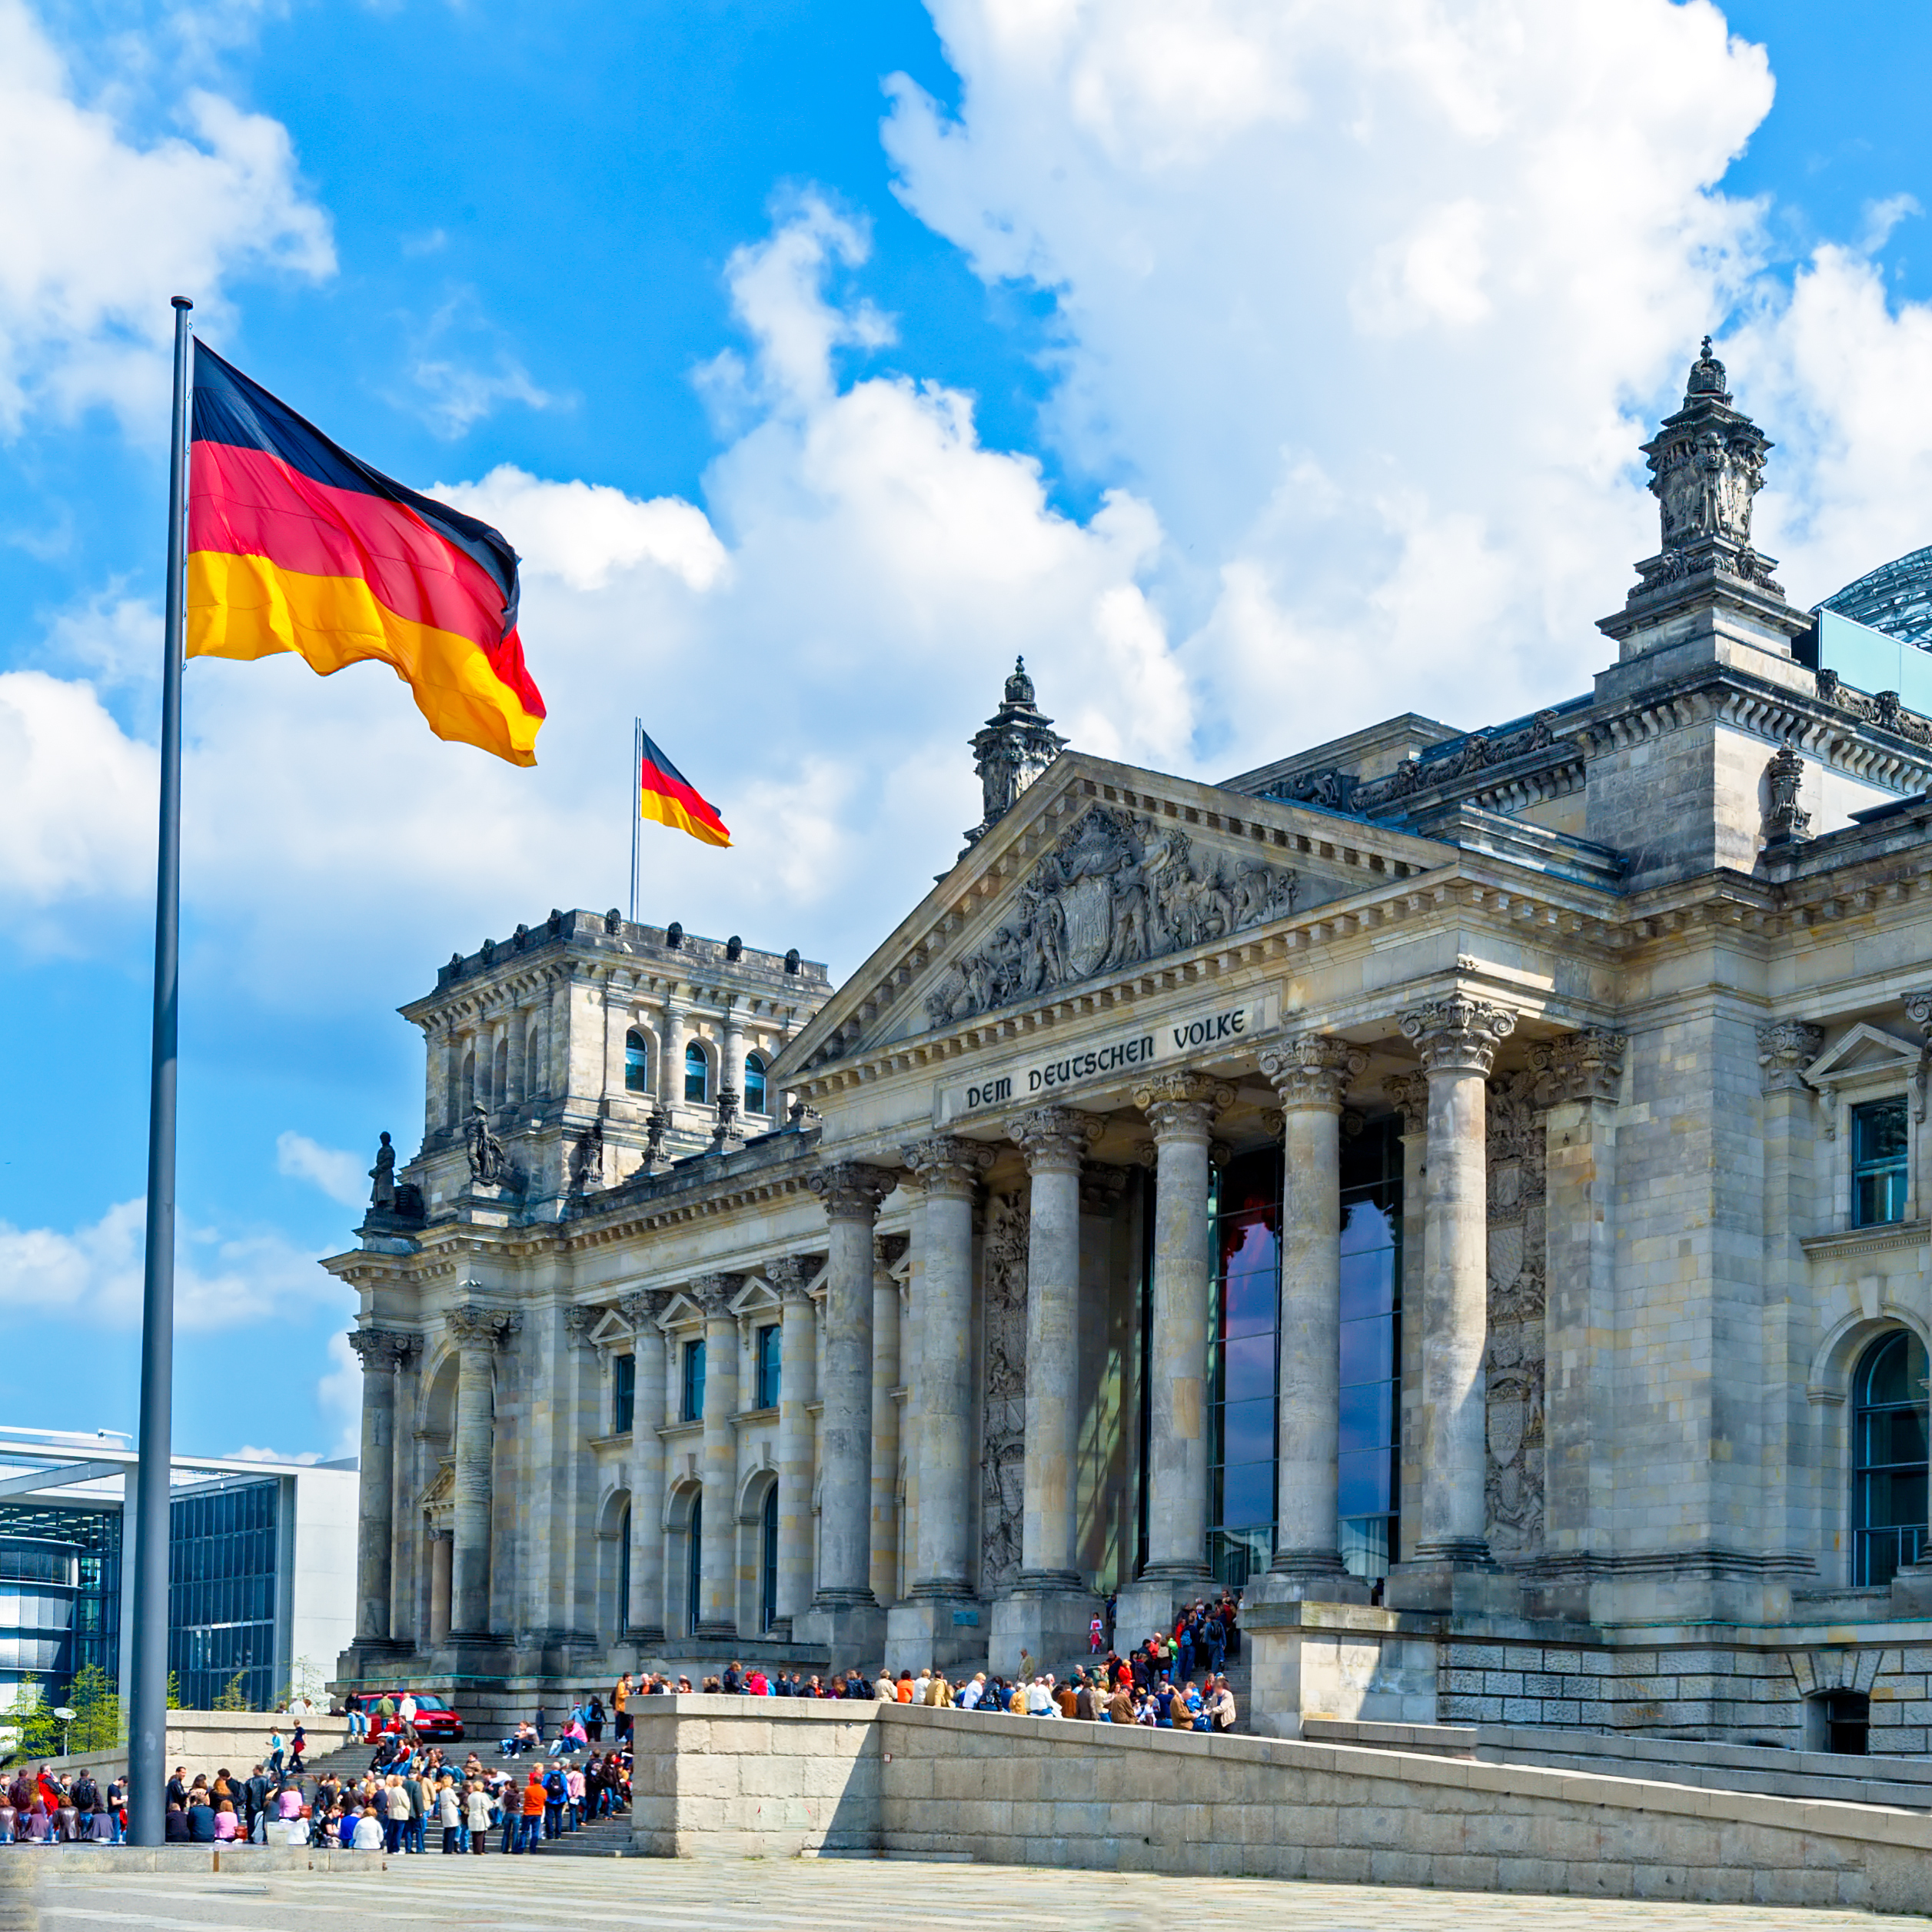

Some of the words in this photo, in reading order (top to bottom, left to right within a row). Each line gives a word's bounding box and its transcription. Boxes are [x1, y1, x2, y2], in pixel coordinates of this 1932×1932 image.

[967, 1077, 1012, 1109] DEM
[1028, 1036, 1154, 1092] DEUTSCHEN
[1173, 1009, 1245, 1049] VOLKE
